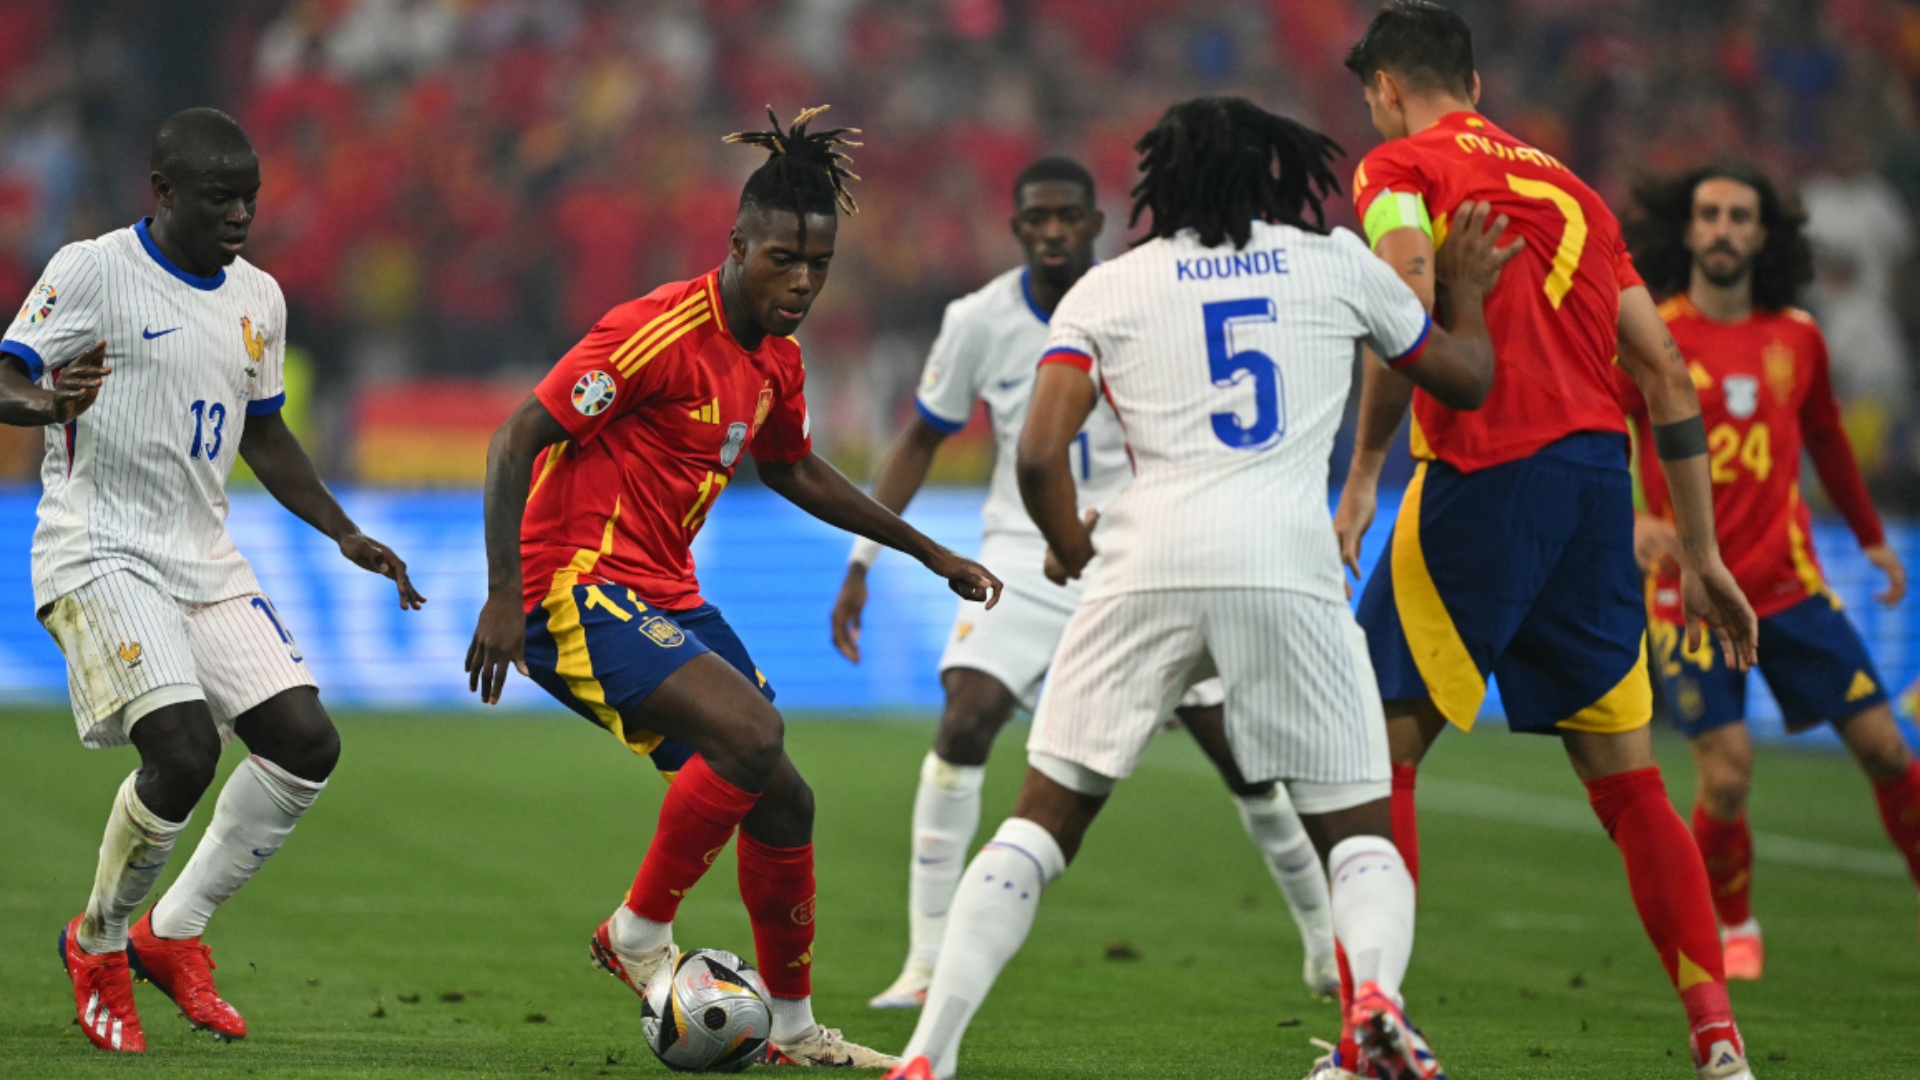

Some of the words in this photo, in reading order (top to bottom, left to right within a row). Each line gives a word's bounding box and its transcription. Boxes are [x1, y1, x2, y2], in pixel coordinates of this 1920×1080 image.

[1177, 249, 1289, 280] KOUNDE
[1506, 172, 1588, 311] 7
[1203, 297, 1285, 450] 5
[190, 399, 226, 460] 13
[1708, 422, 1773, 483] 24
